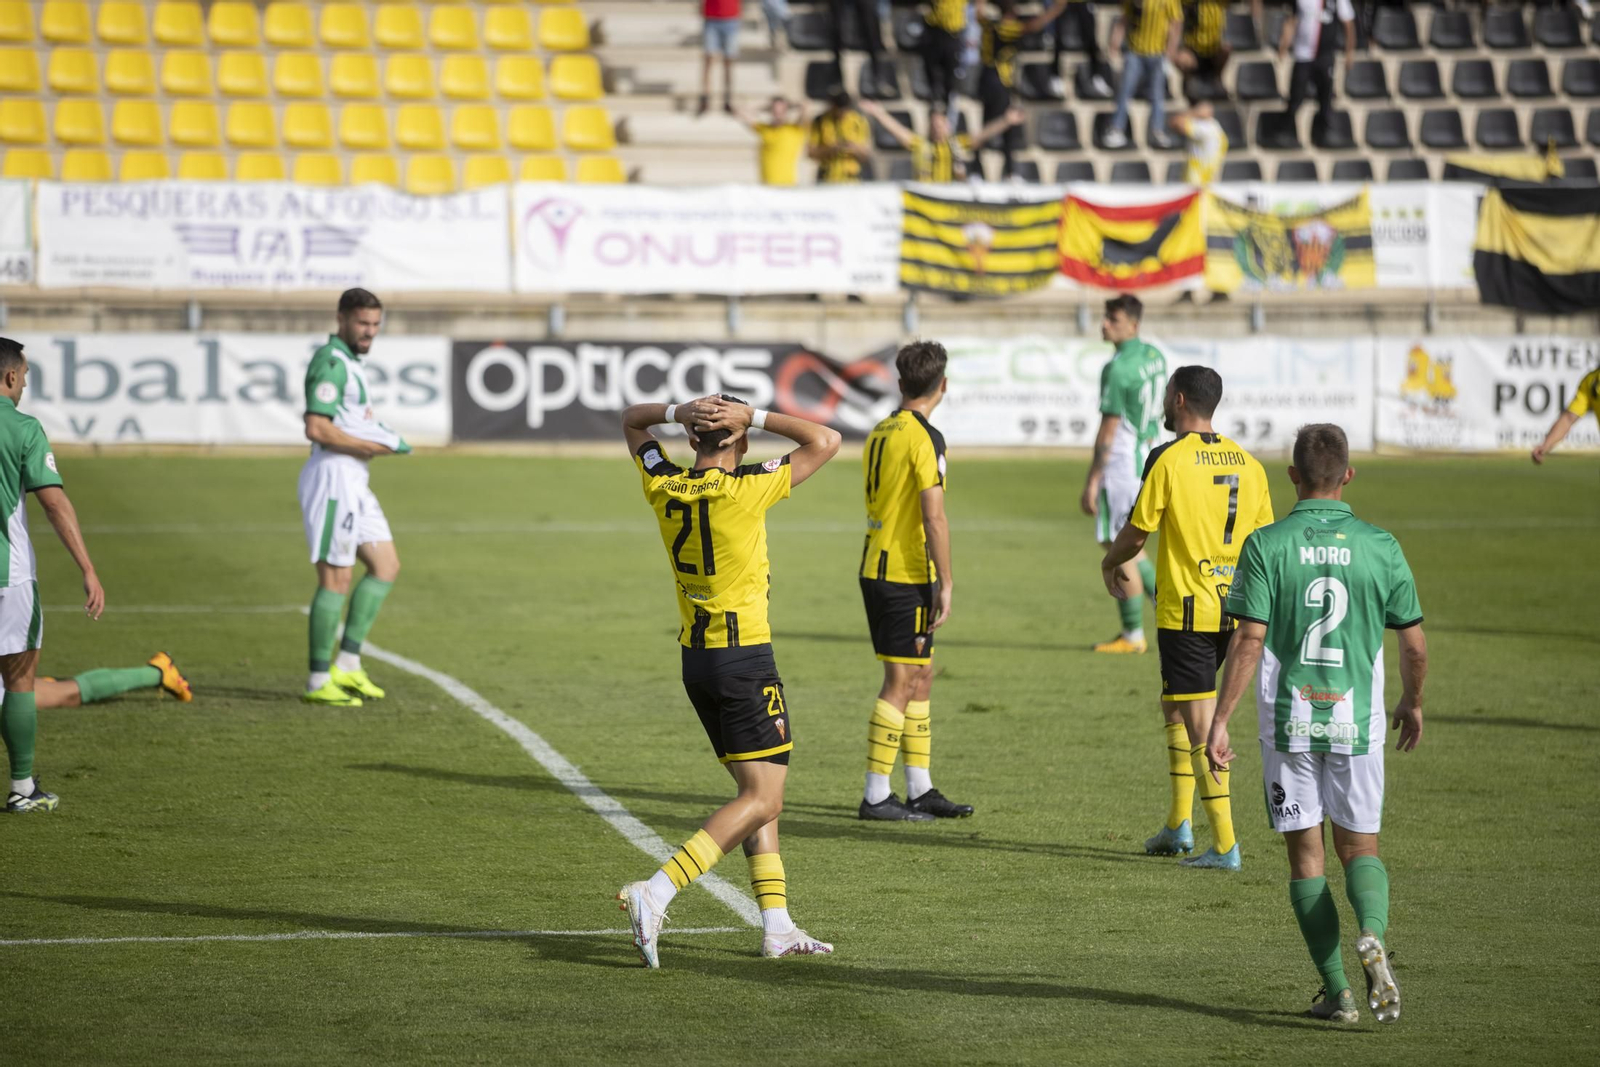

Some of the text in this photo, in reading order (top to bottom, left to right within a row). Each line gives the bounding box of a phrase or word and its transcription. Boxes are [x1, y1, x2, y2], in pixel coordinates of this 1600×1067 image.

[594, 231, 843, 267] ONUFER
[1195, 451, 1246, 466] JACOBO
[342, 512, 355, 533] 4
[1213, 474, 1240, 544] 7
[665, 499, 716, 577] 21
[1300, 546, 1351, 566] MORO
[1300, 576, 1349, 668] 2
[763, 684, 785, 716] 21
